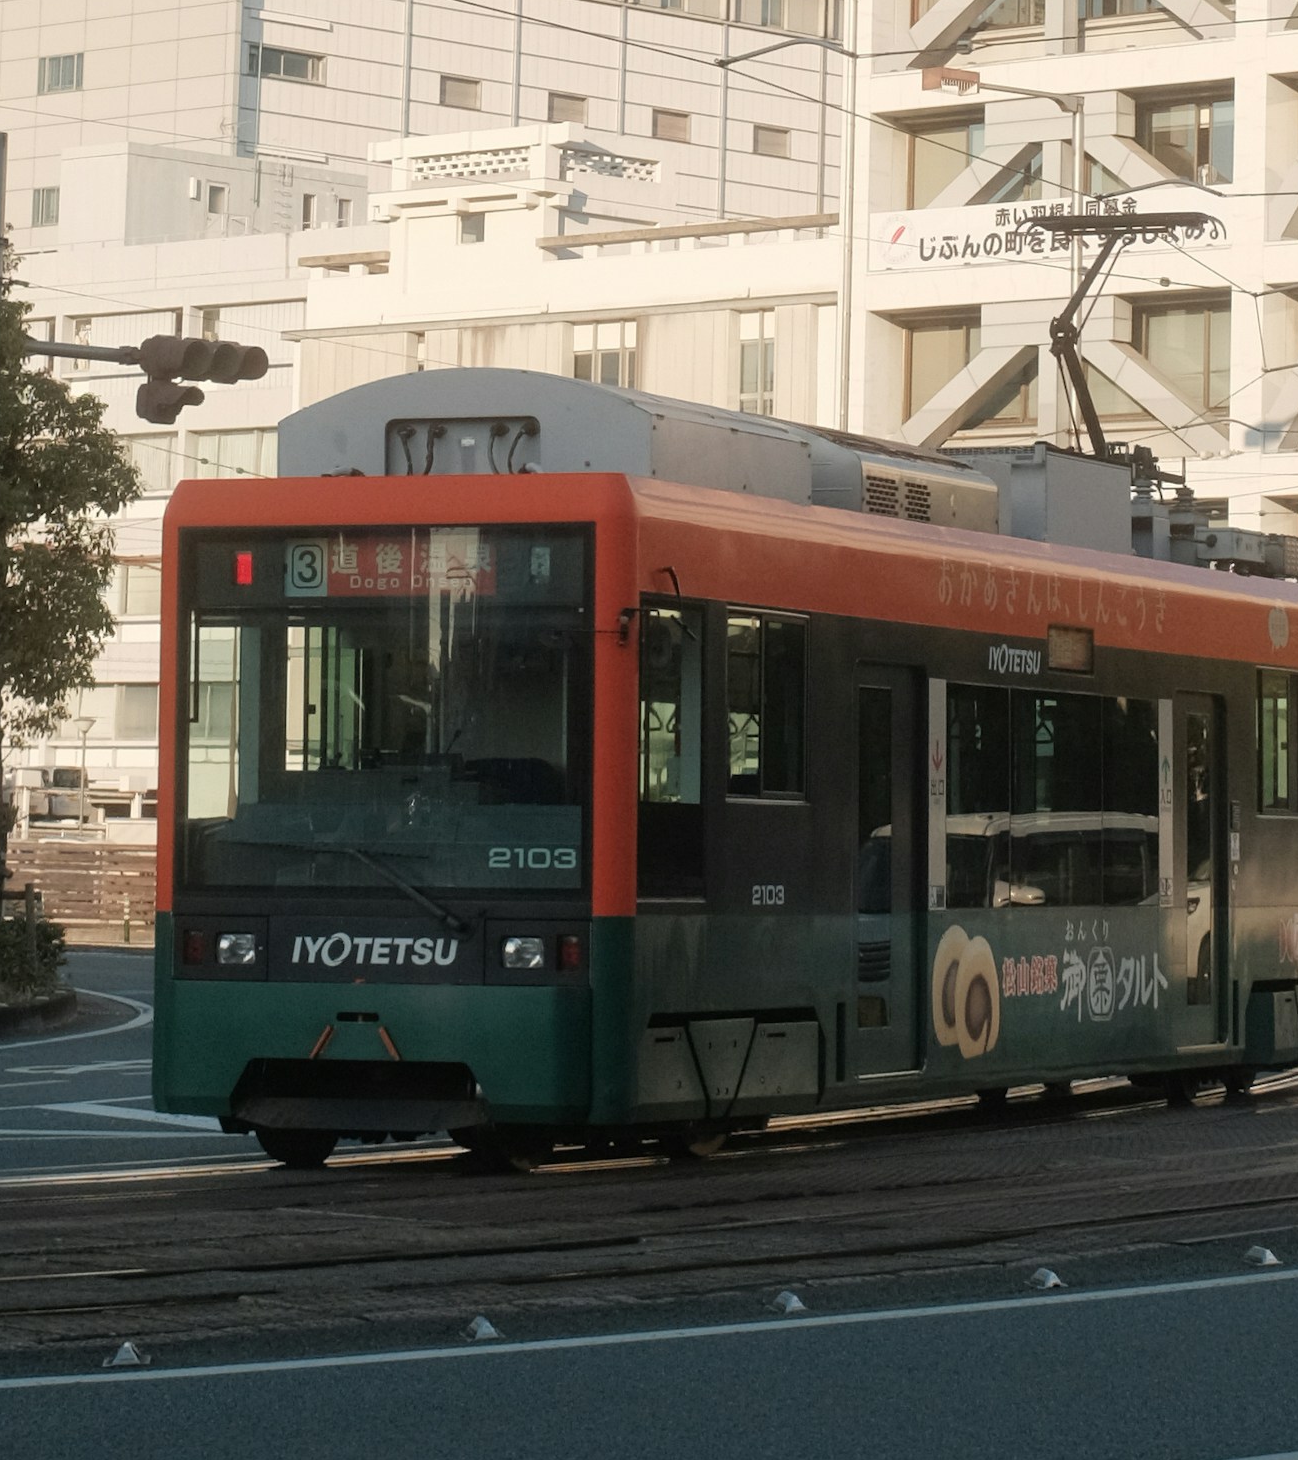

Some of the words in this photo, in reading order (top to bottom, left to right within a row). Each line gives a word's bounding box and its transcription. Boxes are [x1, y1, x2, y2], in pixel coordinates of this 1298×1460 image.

[301, 549, 318, 584] 3
[331, 542, 492, 576] 道後温泉
[350, 574, 401, 591] Dogo
[987, 643, 1041, 675] IYOTETSU
[488, 847, 578, 870] 2103
[751, 884, 785, 906] 2103
[291, 931, 459, 967] IYOTETSU
[1002, 954, 1059, 998] 松山銘菓
